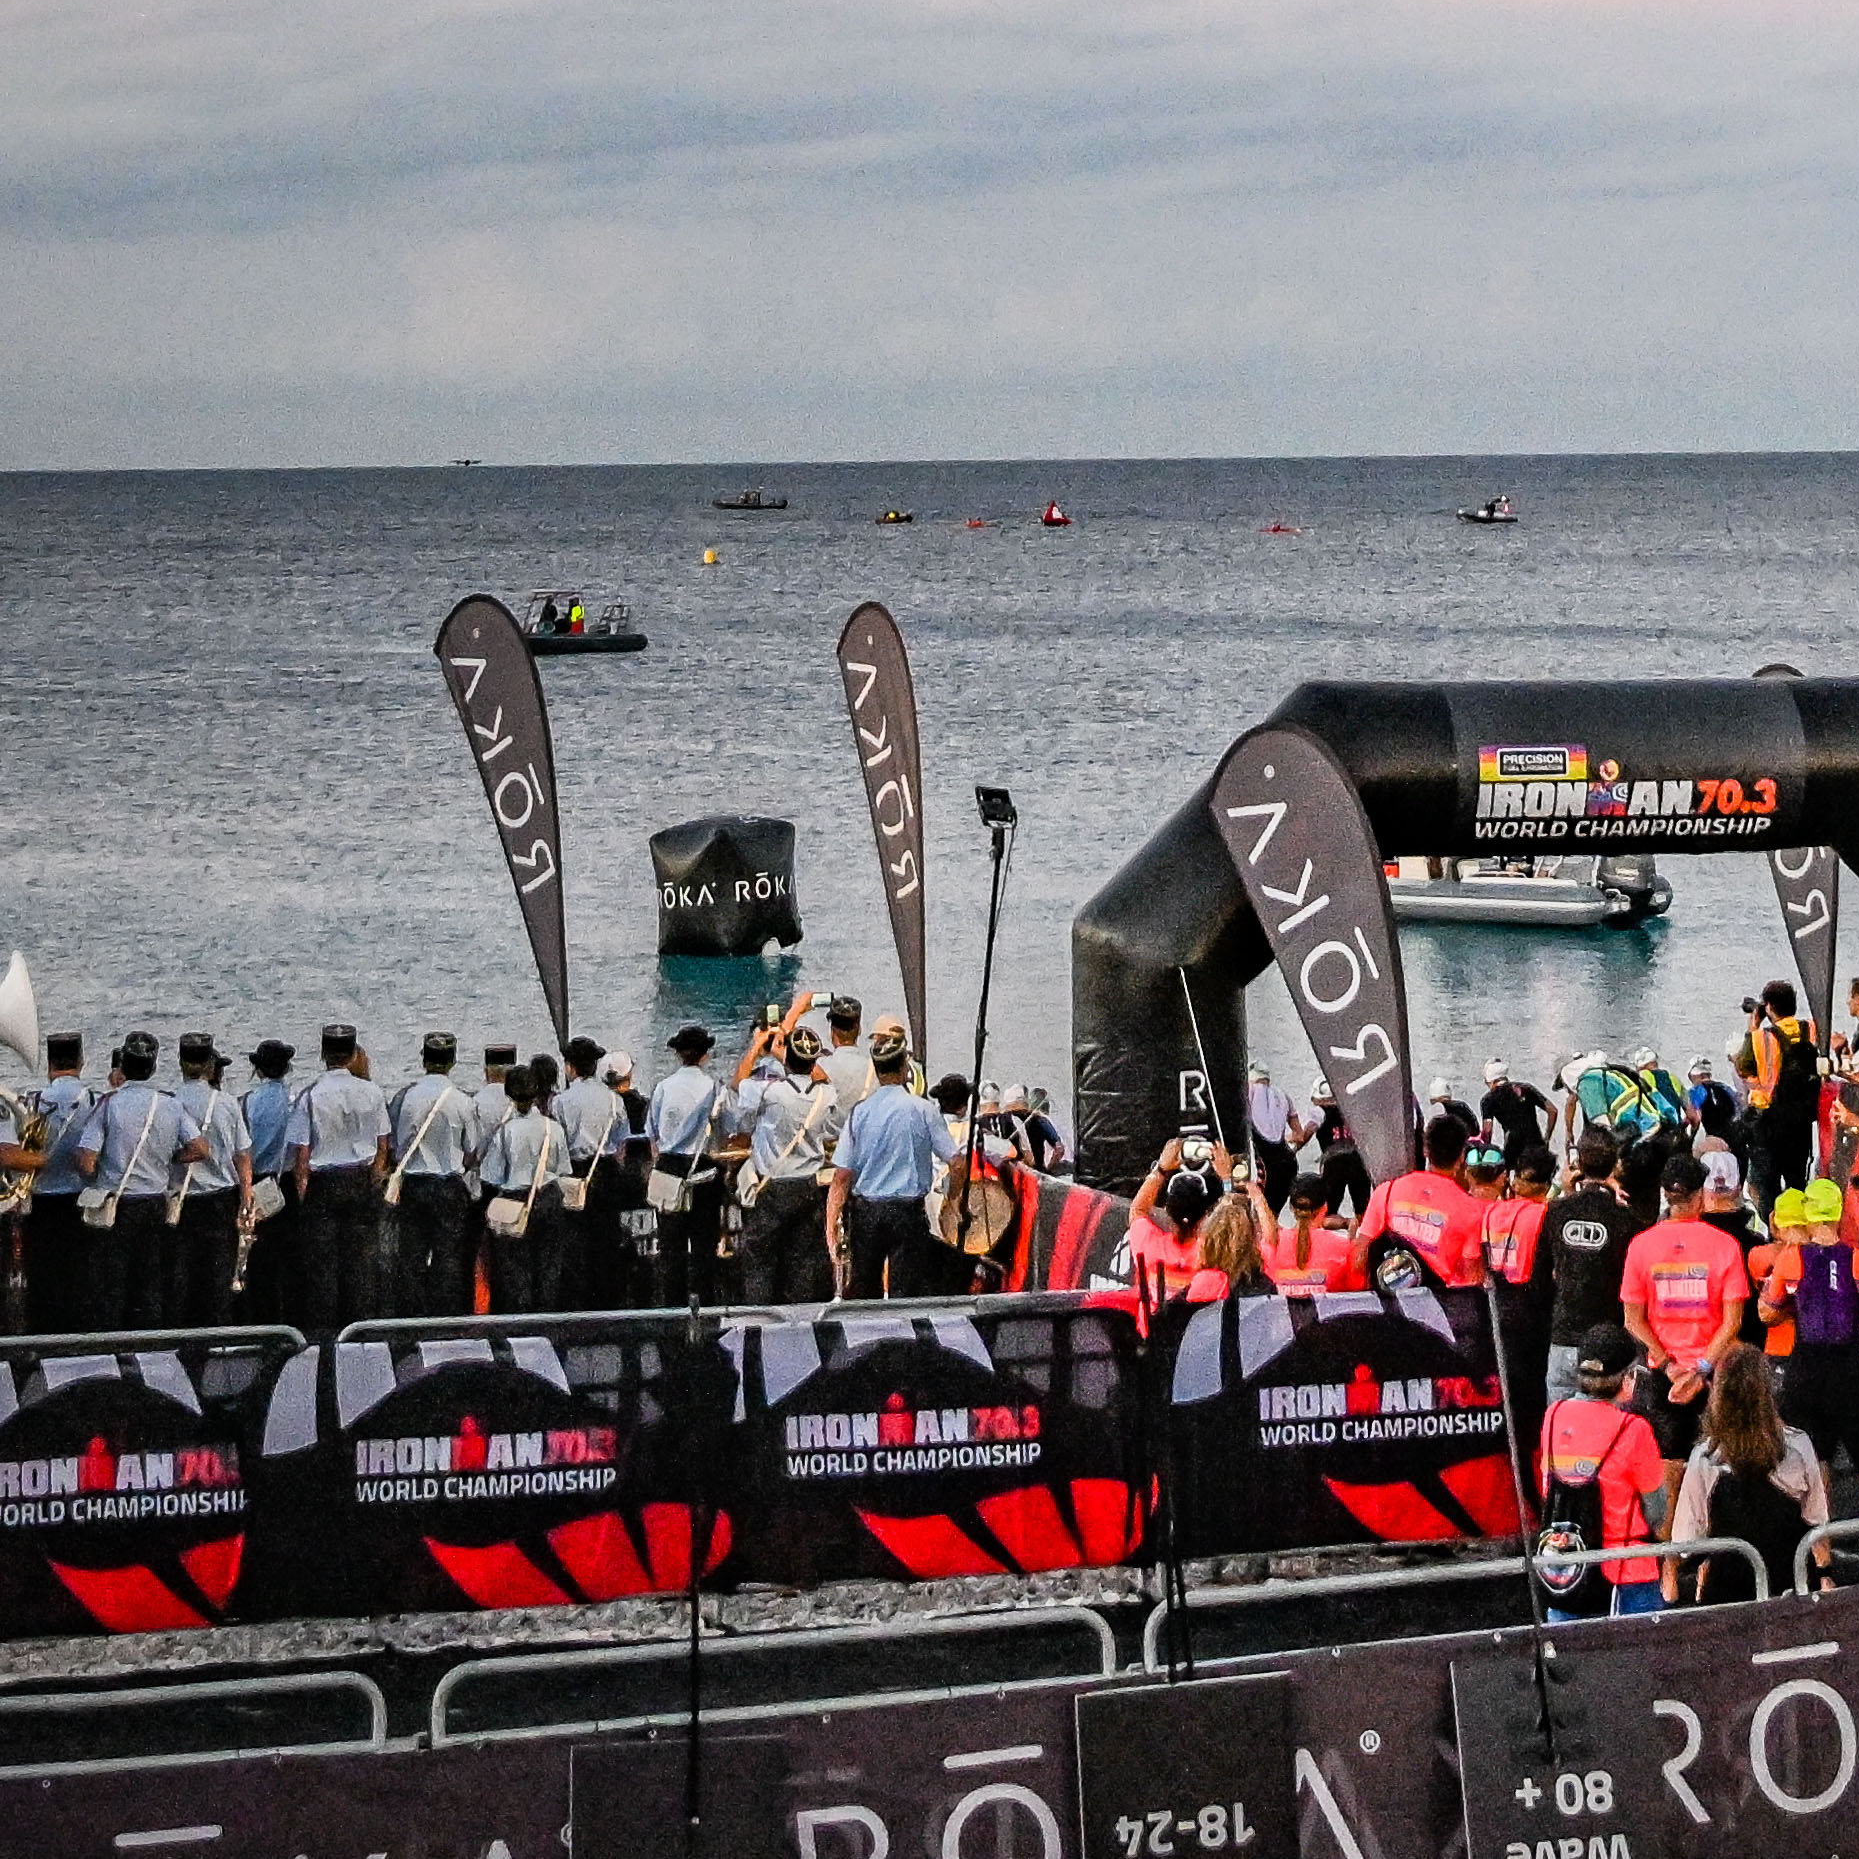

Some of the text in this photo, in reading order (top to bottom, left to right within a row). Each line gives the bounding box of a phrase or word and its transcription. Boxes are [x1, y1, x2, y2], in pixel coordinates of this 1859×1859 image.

[1503, 754, 1563, 765] PRECISION
[1474, 817, 1772, 839] WORLD CHAMPIONSHIP
[1260, 1411, 1503, 1447] WORLD CHAMPIONSHIP
[787, 1442, 1042, 1477] WORLD CHAMPIONSHIP
[357, 1467, 617, 1503] WORLD CHAMPIONSHIP
[1555, 1770, 1613, 1815] 80
[1117, 1802, 1256, 1857] 18-24
